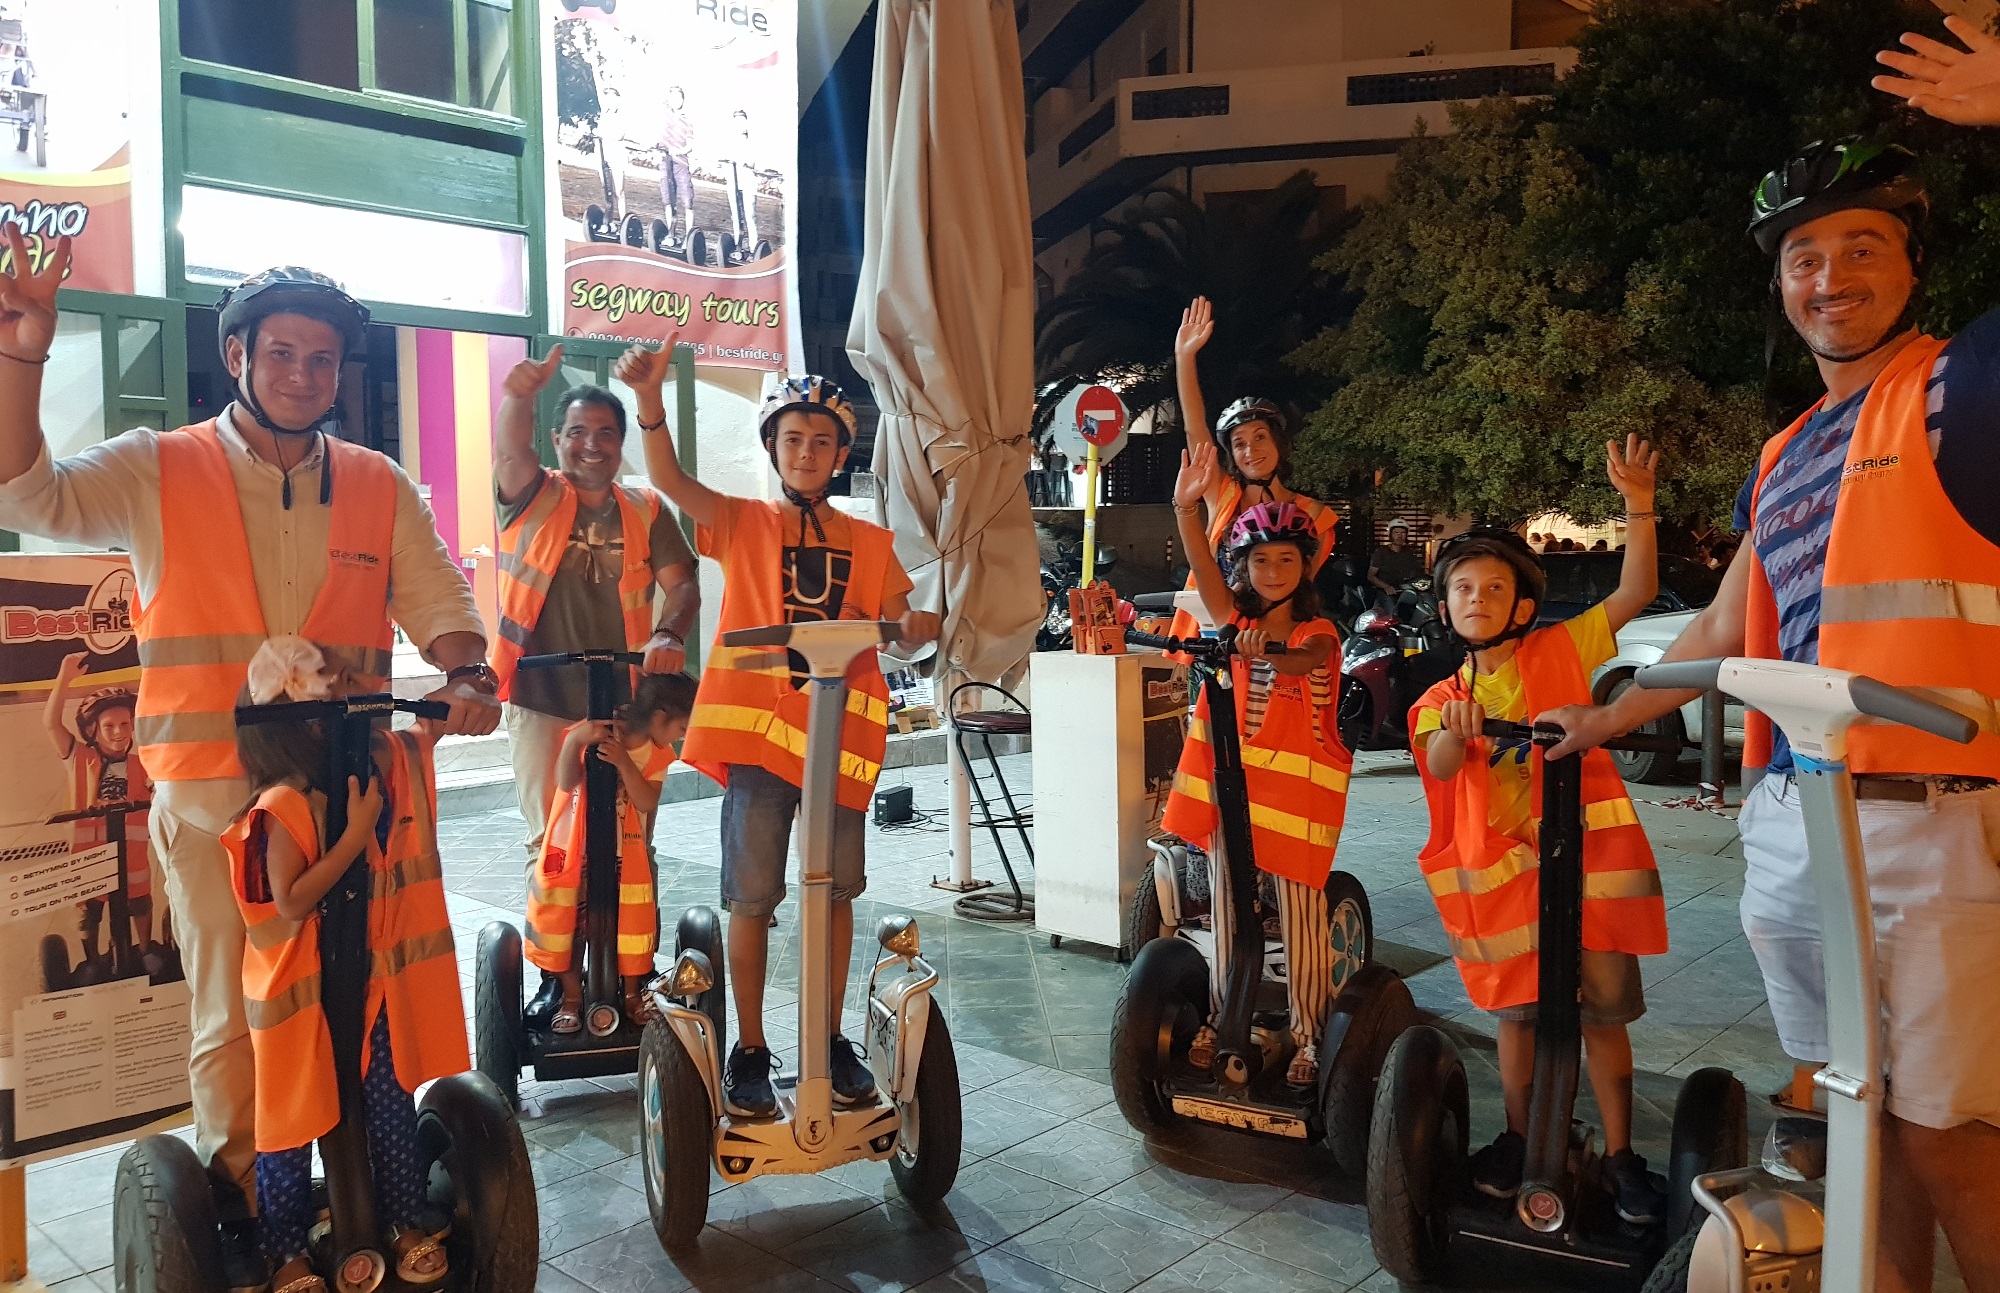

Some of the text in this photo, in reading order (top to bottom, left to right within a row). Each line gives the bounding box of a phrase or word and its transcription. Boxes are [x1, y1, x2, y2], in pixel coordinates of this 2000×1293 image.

[571, 278, 780, 328] segway tours
[716, 344, 784, 364] bestride.gr
[23, 850, 107, 879] RETHYMNO BY NIGHT
[23, 875, 82, 897] GRANDE TOUR
[24, 883, 108, 914] TOUR ON THE BEACH
